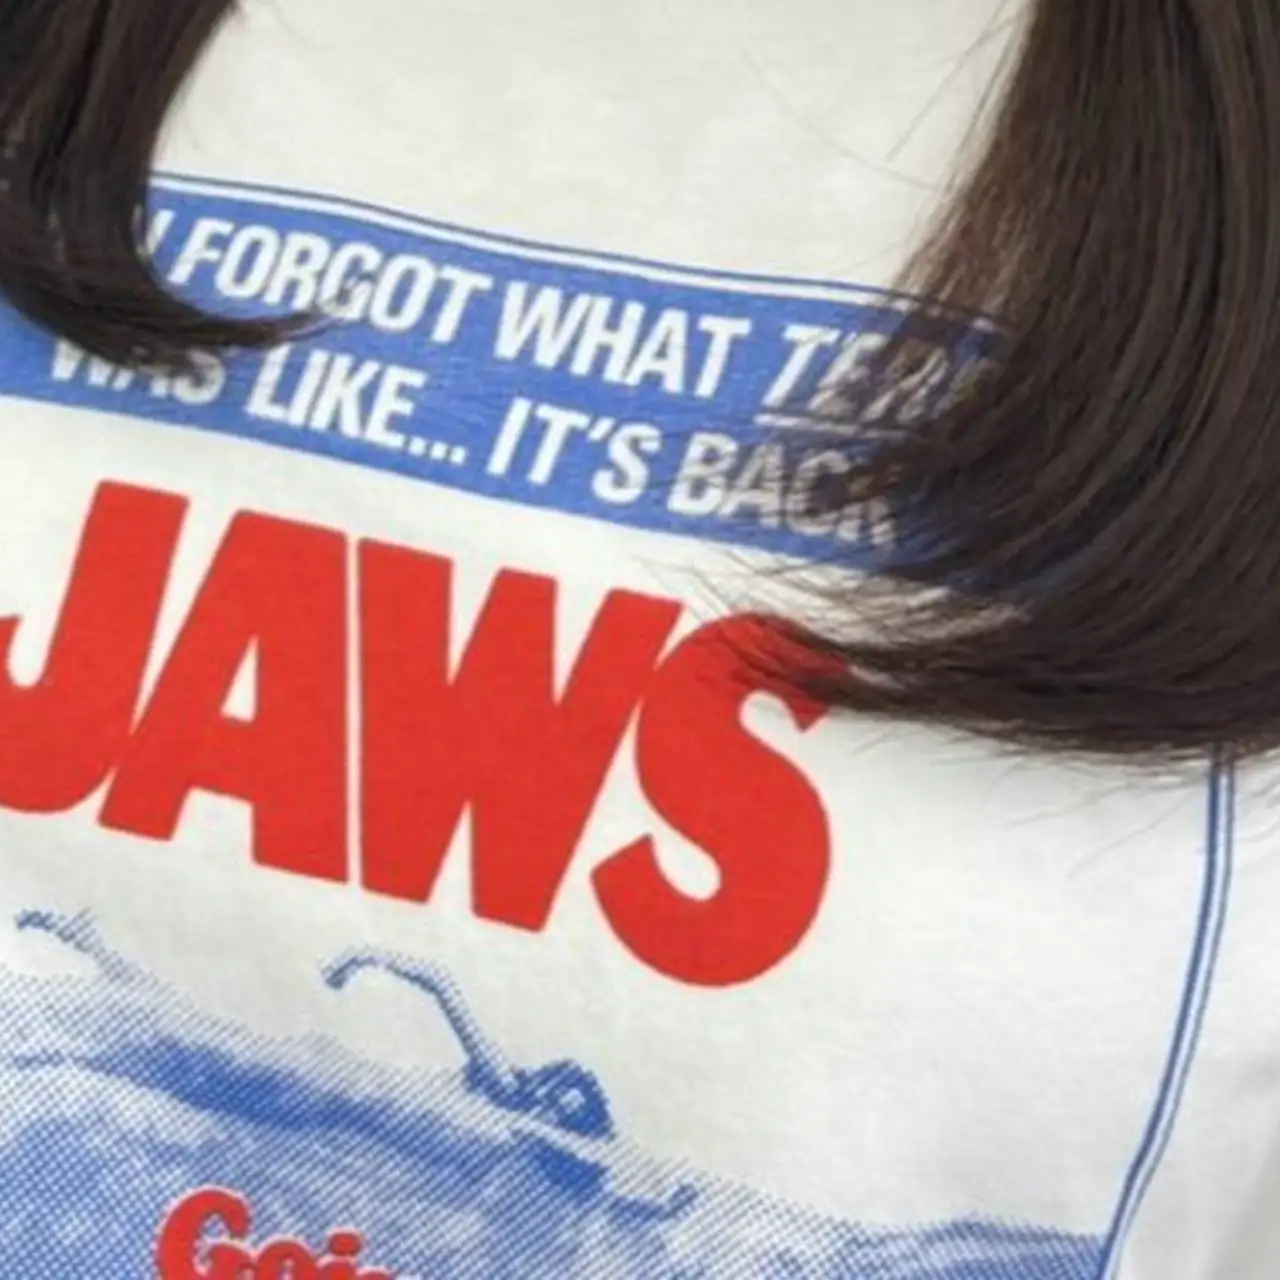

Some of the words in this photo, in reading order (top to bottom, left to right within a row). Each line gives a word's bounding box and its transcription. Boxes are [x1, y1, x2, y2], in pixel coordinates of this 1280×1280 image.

[166, 213, 493, 344] FORGOT
[493, 279, 754, 399] WHAT
[244, 343, 470, 464] LIKE...
[485, 395, 662, 505] IT'S
[155, 1185, 420, 1280] Goi
